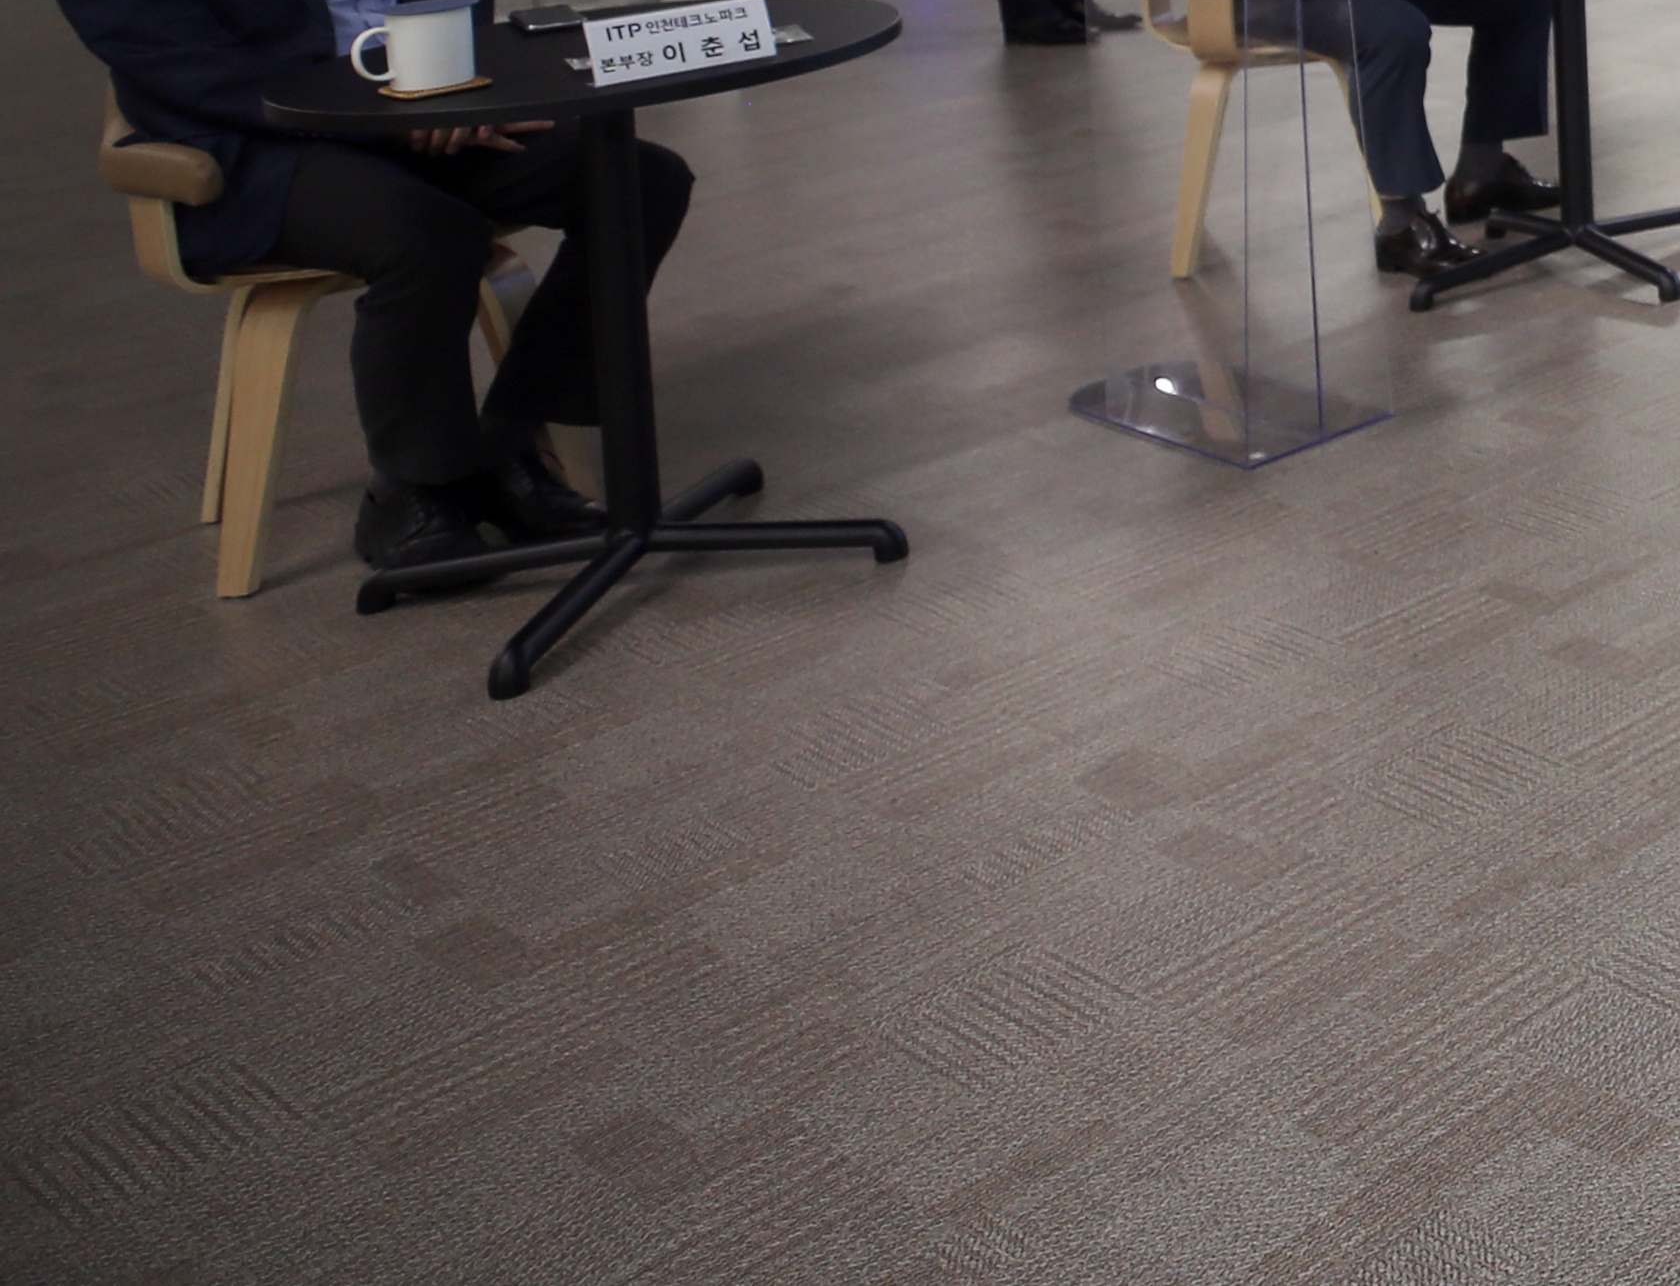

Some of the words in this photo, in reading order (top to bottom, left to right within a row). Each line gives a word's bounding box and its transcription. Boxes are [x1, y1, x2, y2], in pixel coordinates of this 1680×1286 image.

[606, 23, 642, 42] ITP
[645, 7, 748, 35] 인천테크노파크
[601, 51, 653, 74] 본부장
